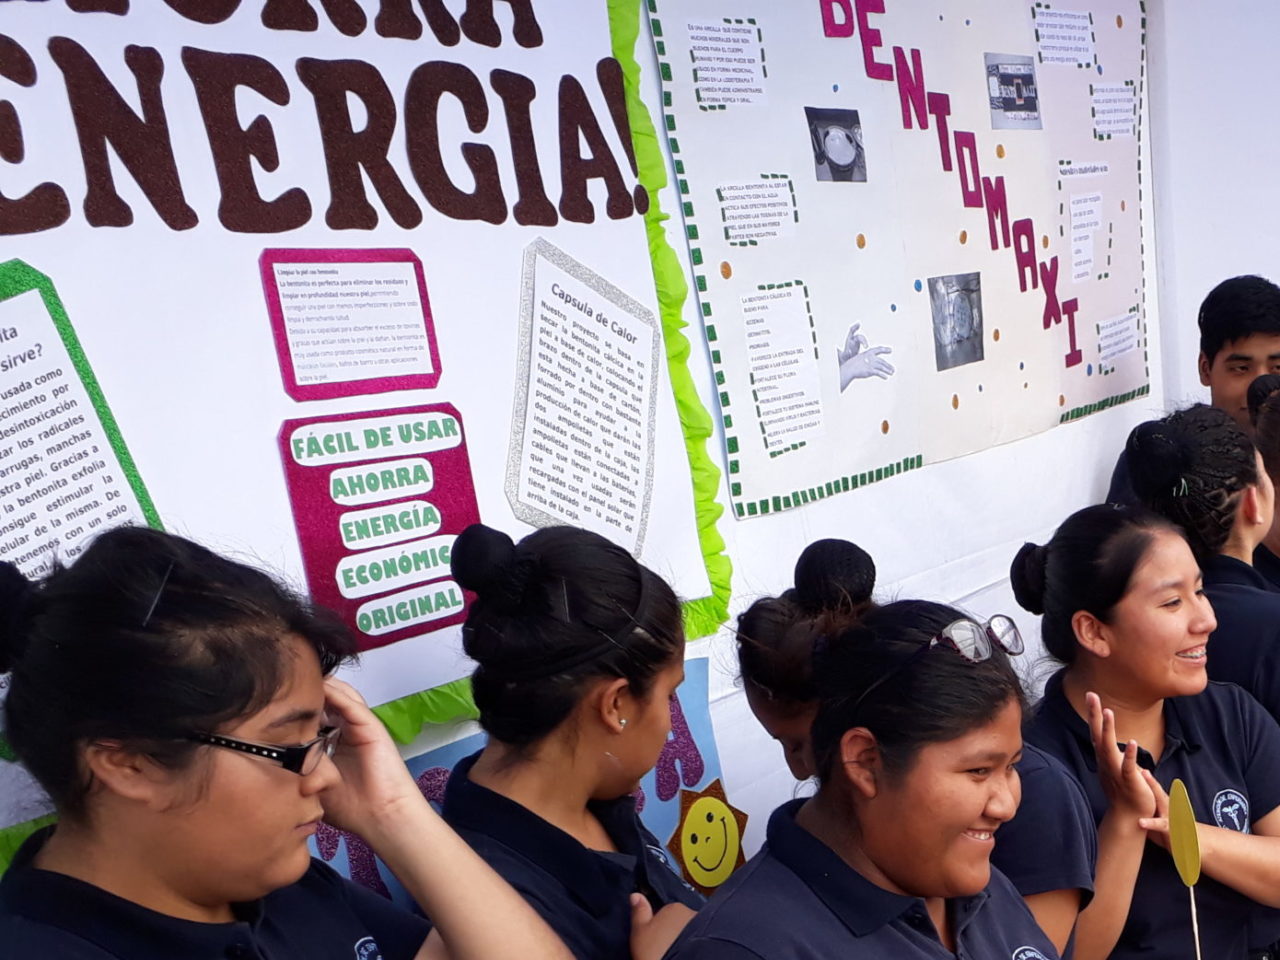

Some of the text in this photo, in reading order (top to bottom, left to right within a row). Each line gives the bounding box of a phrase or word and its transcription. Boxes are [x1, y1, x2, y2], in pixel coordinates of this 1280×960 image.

[551, 283, 637, 344] Capsula de Calor
[1, 342, 44, 372] sirve?
[0, 368, 63, 400] usada como
[52, 384, 69, 399] por
[17, 415, 85, 450] los radicales
[293, 417, 458, 460] FÁCIL DE USAR
[0, 430, 92, 478] arrugas, manchas
[24, 445, 99, 487] piel. Gracias a
[3, 460, 106, 514] la bentonita exfolia
[46, 475, 113, 512] estimular la
[332, 464, 430, 499] AHORRA
[34, 490, 121, 537] de la misma. De
[65, 505, 127, 540] con un solo
[342, 504, 440, 543] ENERGÍA
[342, 545, 451, 589] ECONÓMIC
[358, 588, 462, 633] ORIGINAL
